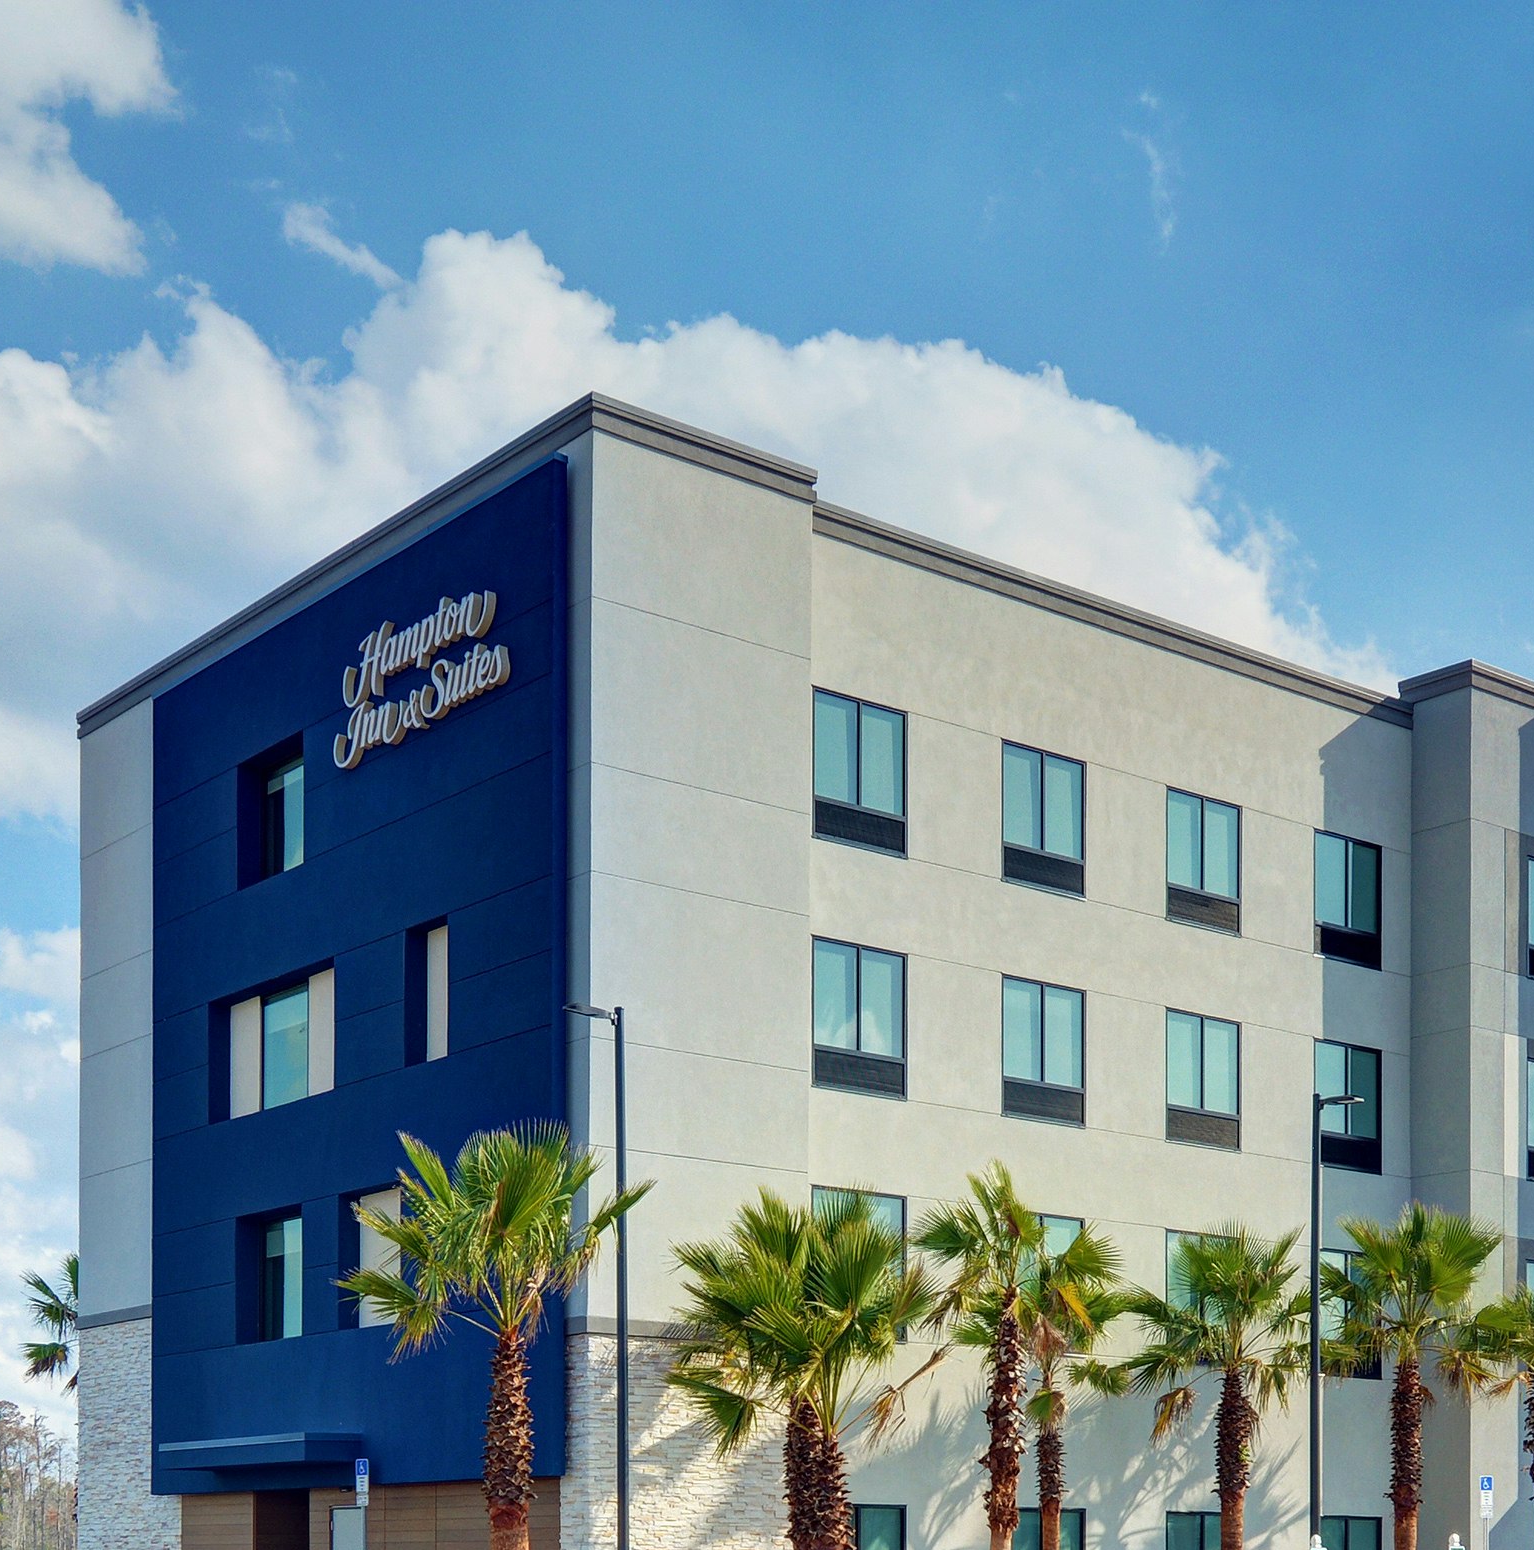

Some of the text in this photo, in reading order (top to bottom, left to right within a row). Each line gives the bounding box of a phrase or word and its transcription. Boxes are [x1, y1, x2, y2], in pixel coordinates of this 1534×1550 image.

[333, 643, 510, 769] Inn & Suites
[343, 590, 496, 708] Hampton
